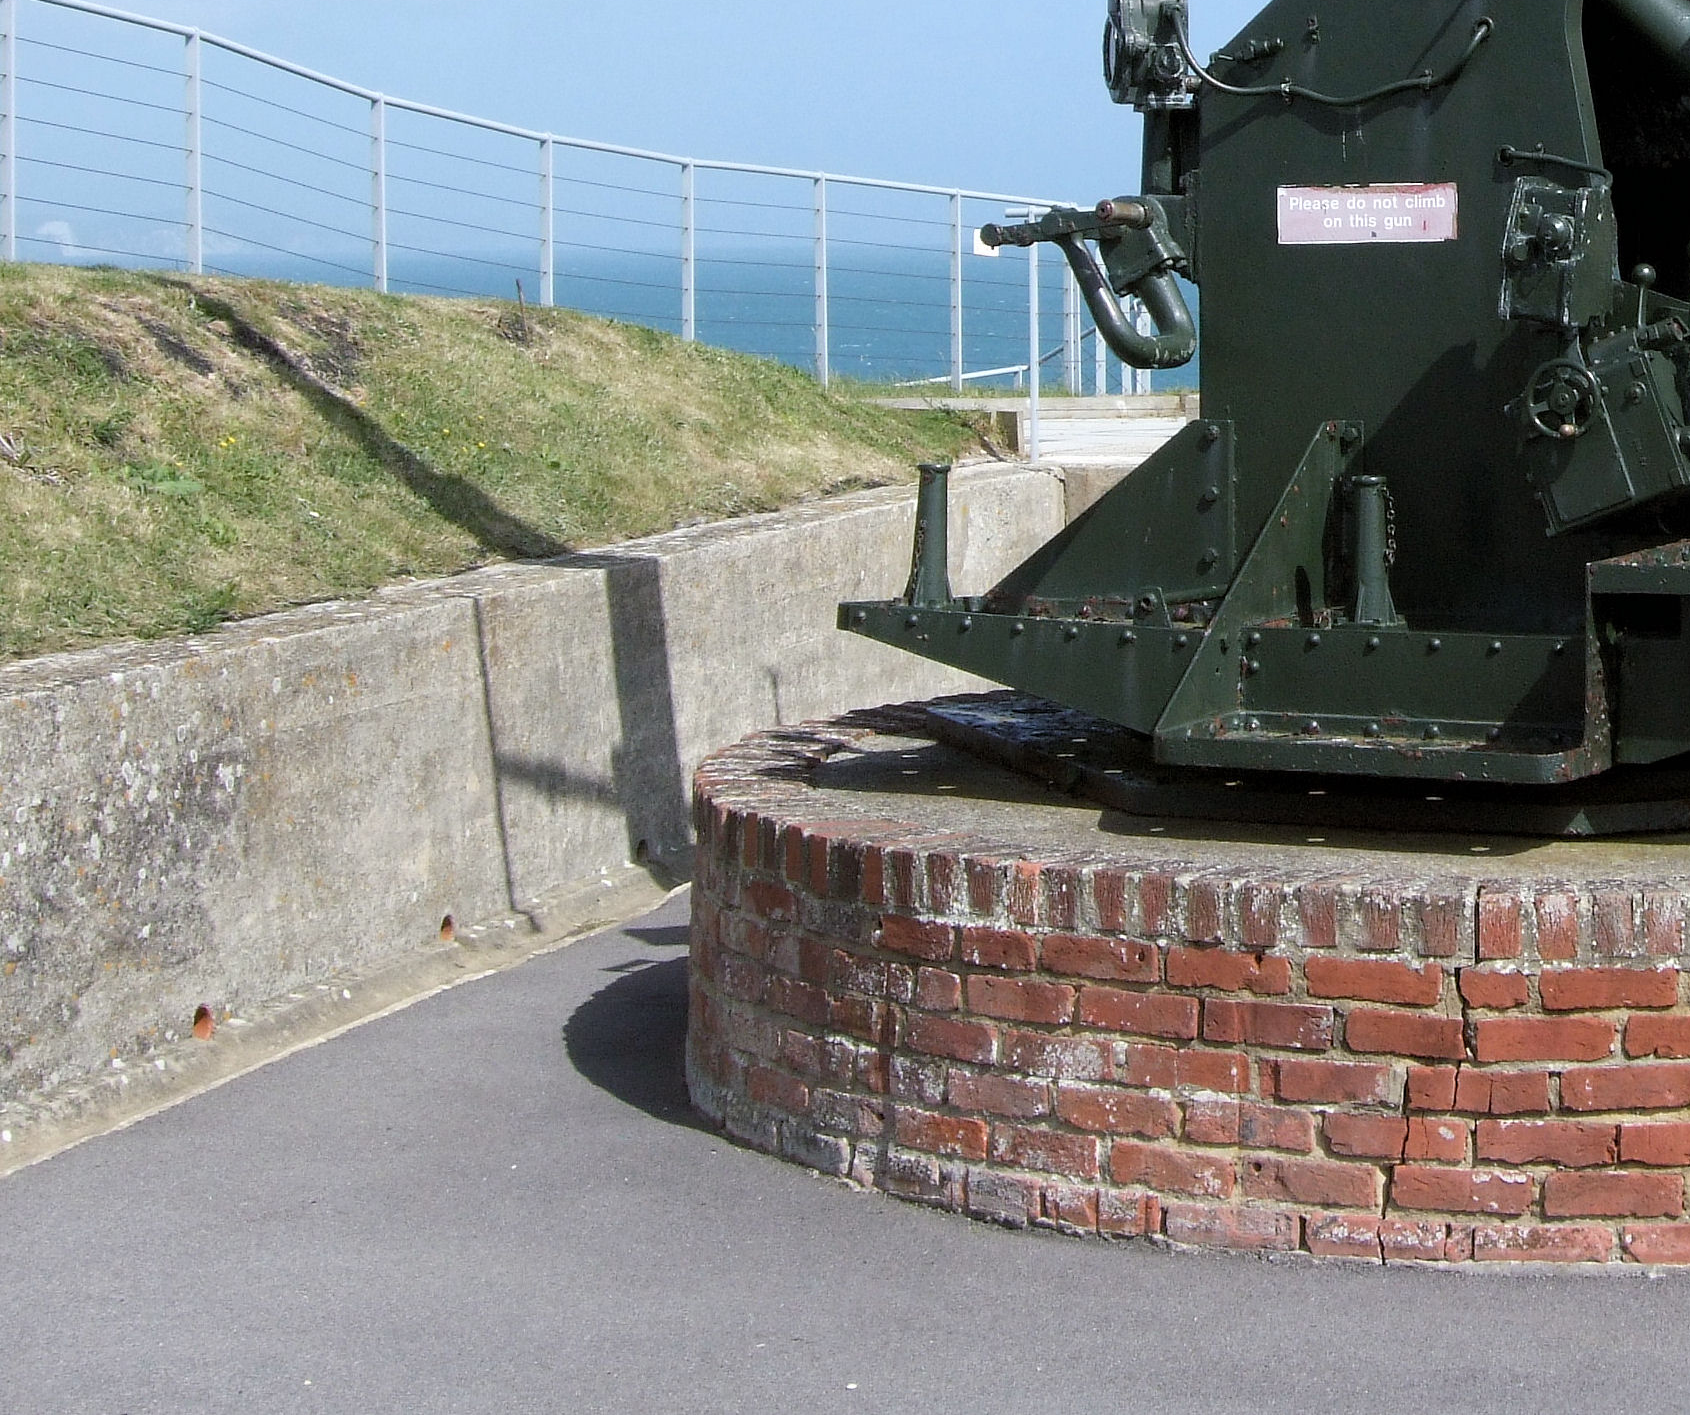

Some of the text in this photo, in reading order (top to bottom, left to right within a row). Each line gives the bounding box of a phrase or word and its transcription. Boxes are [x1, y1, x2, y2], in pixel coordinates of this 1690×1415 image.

[1289, 194, 1446, 211] Please do not climb
[1323, 213, 1412, 230] on this gun
